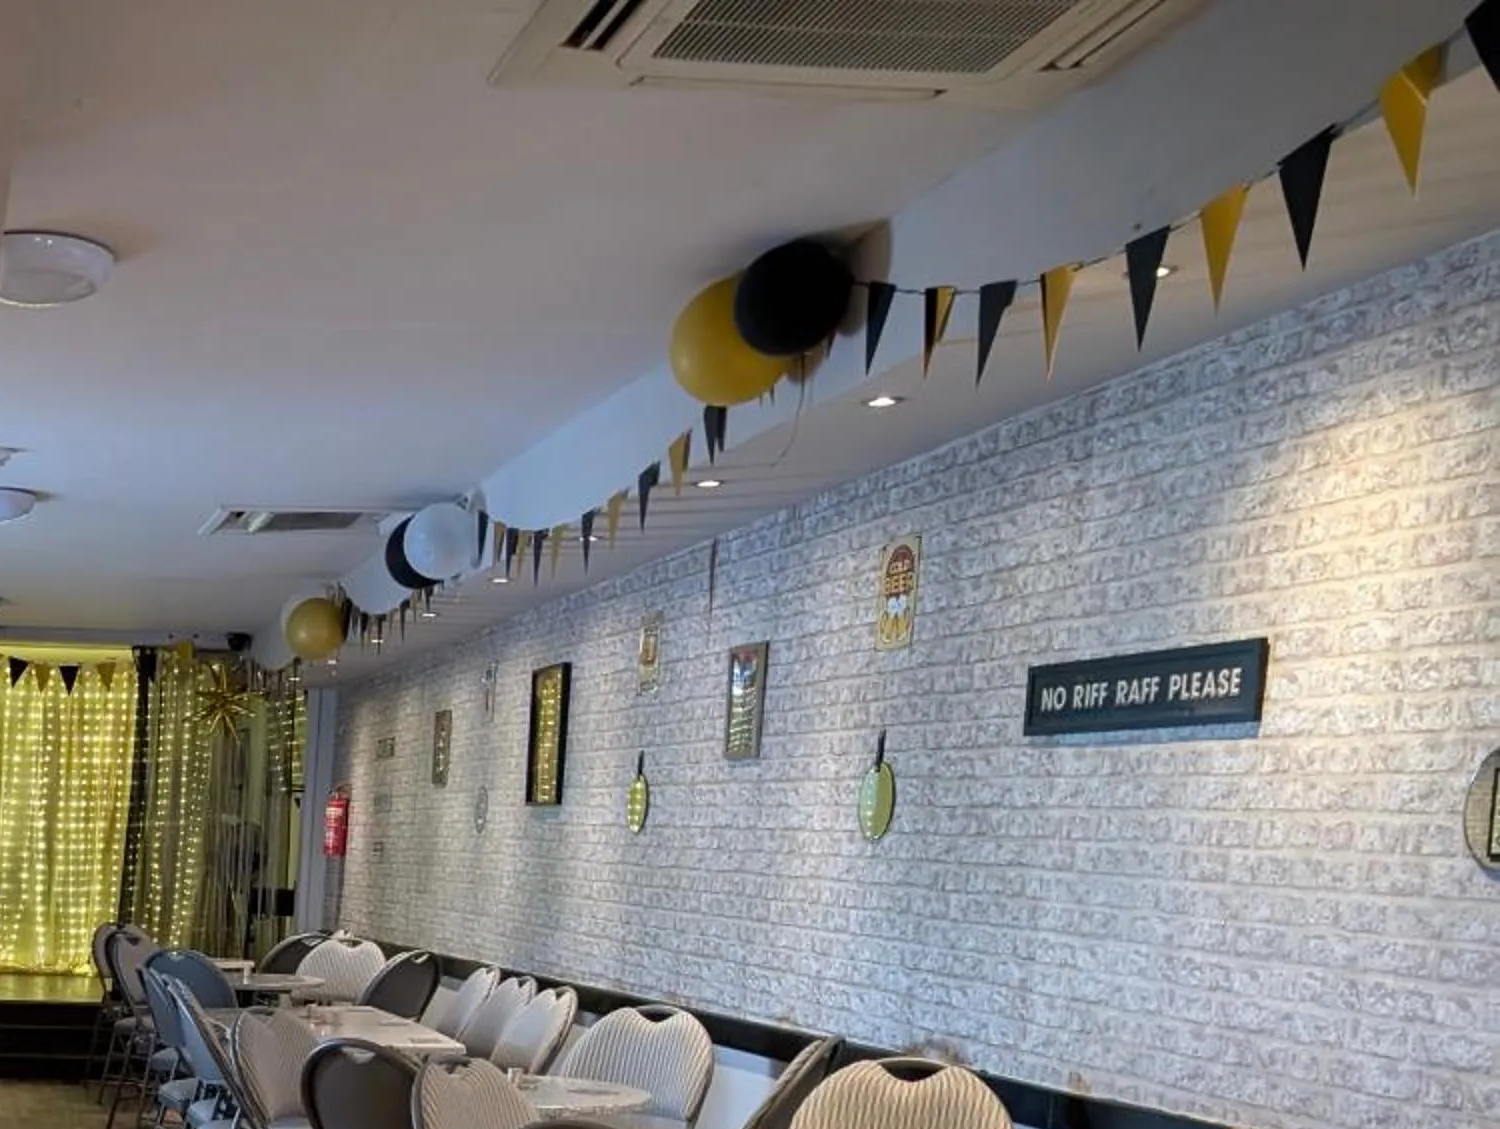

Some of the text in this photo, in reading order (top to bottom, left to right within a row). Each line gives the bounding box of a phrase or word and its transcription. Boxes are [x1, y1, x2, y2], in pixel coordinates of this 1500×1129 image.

[883, 573, 915, 596] BEER
[1040, 666, 1243, 713] NO RIFF RAFF PLEASE
